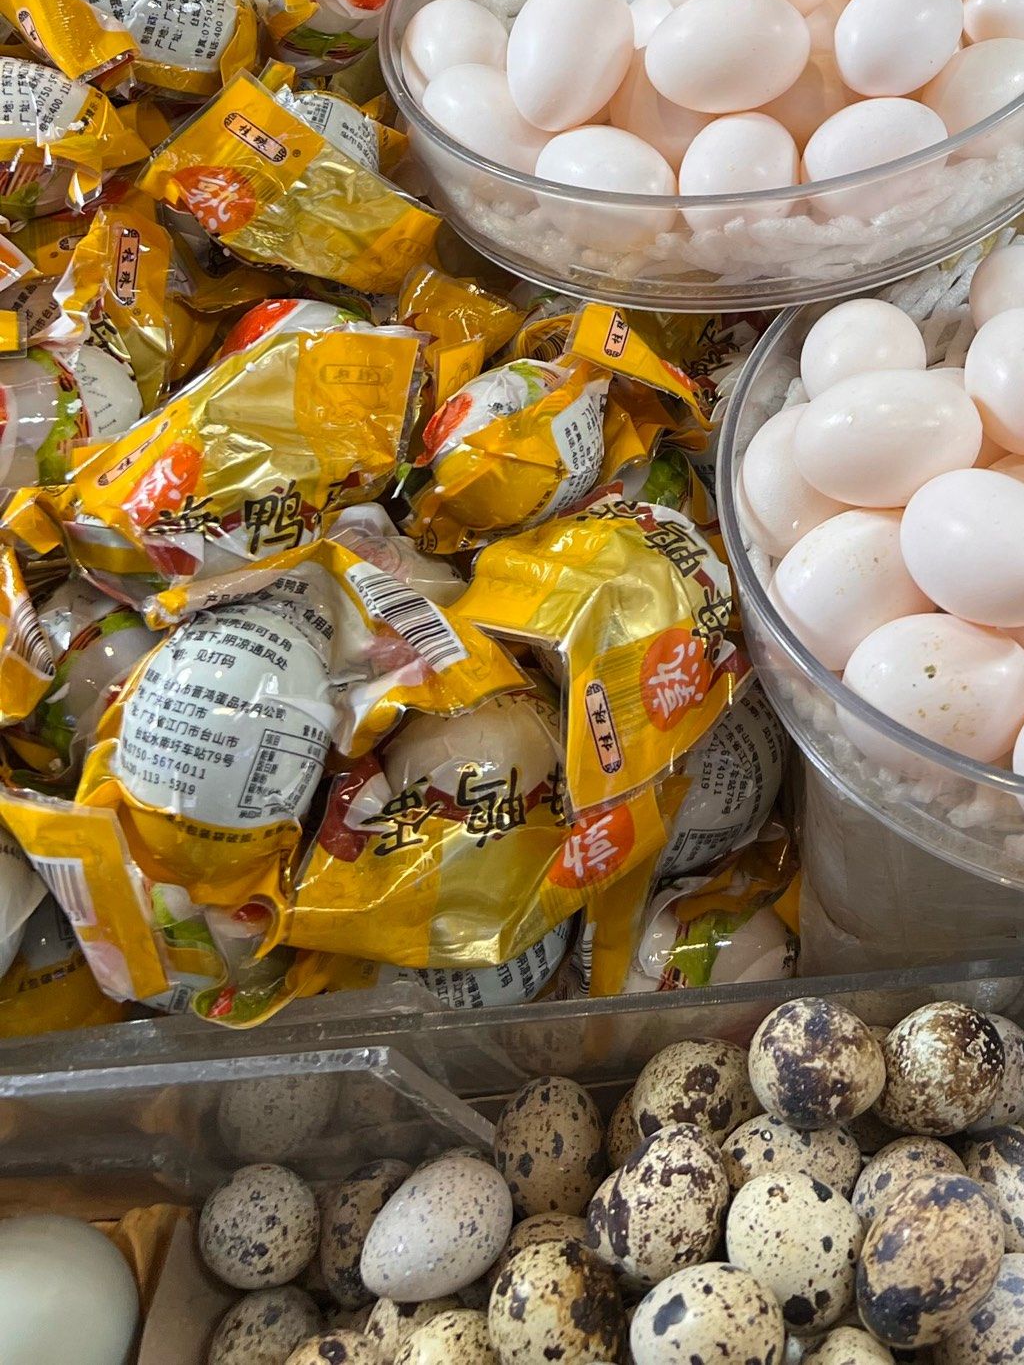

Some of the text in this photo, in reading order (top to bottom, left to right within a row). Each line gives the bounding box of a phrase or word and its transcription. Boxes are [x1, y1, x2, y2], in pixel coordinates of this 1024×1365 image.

[194, 649, 237, 670] 见打码
[648, 639, 708, 721] 熟
